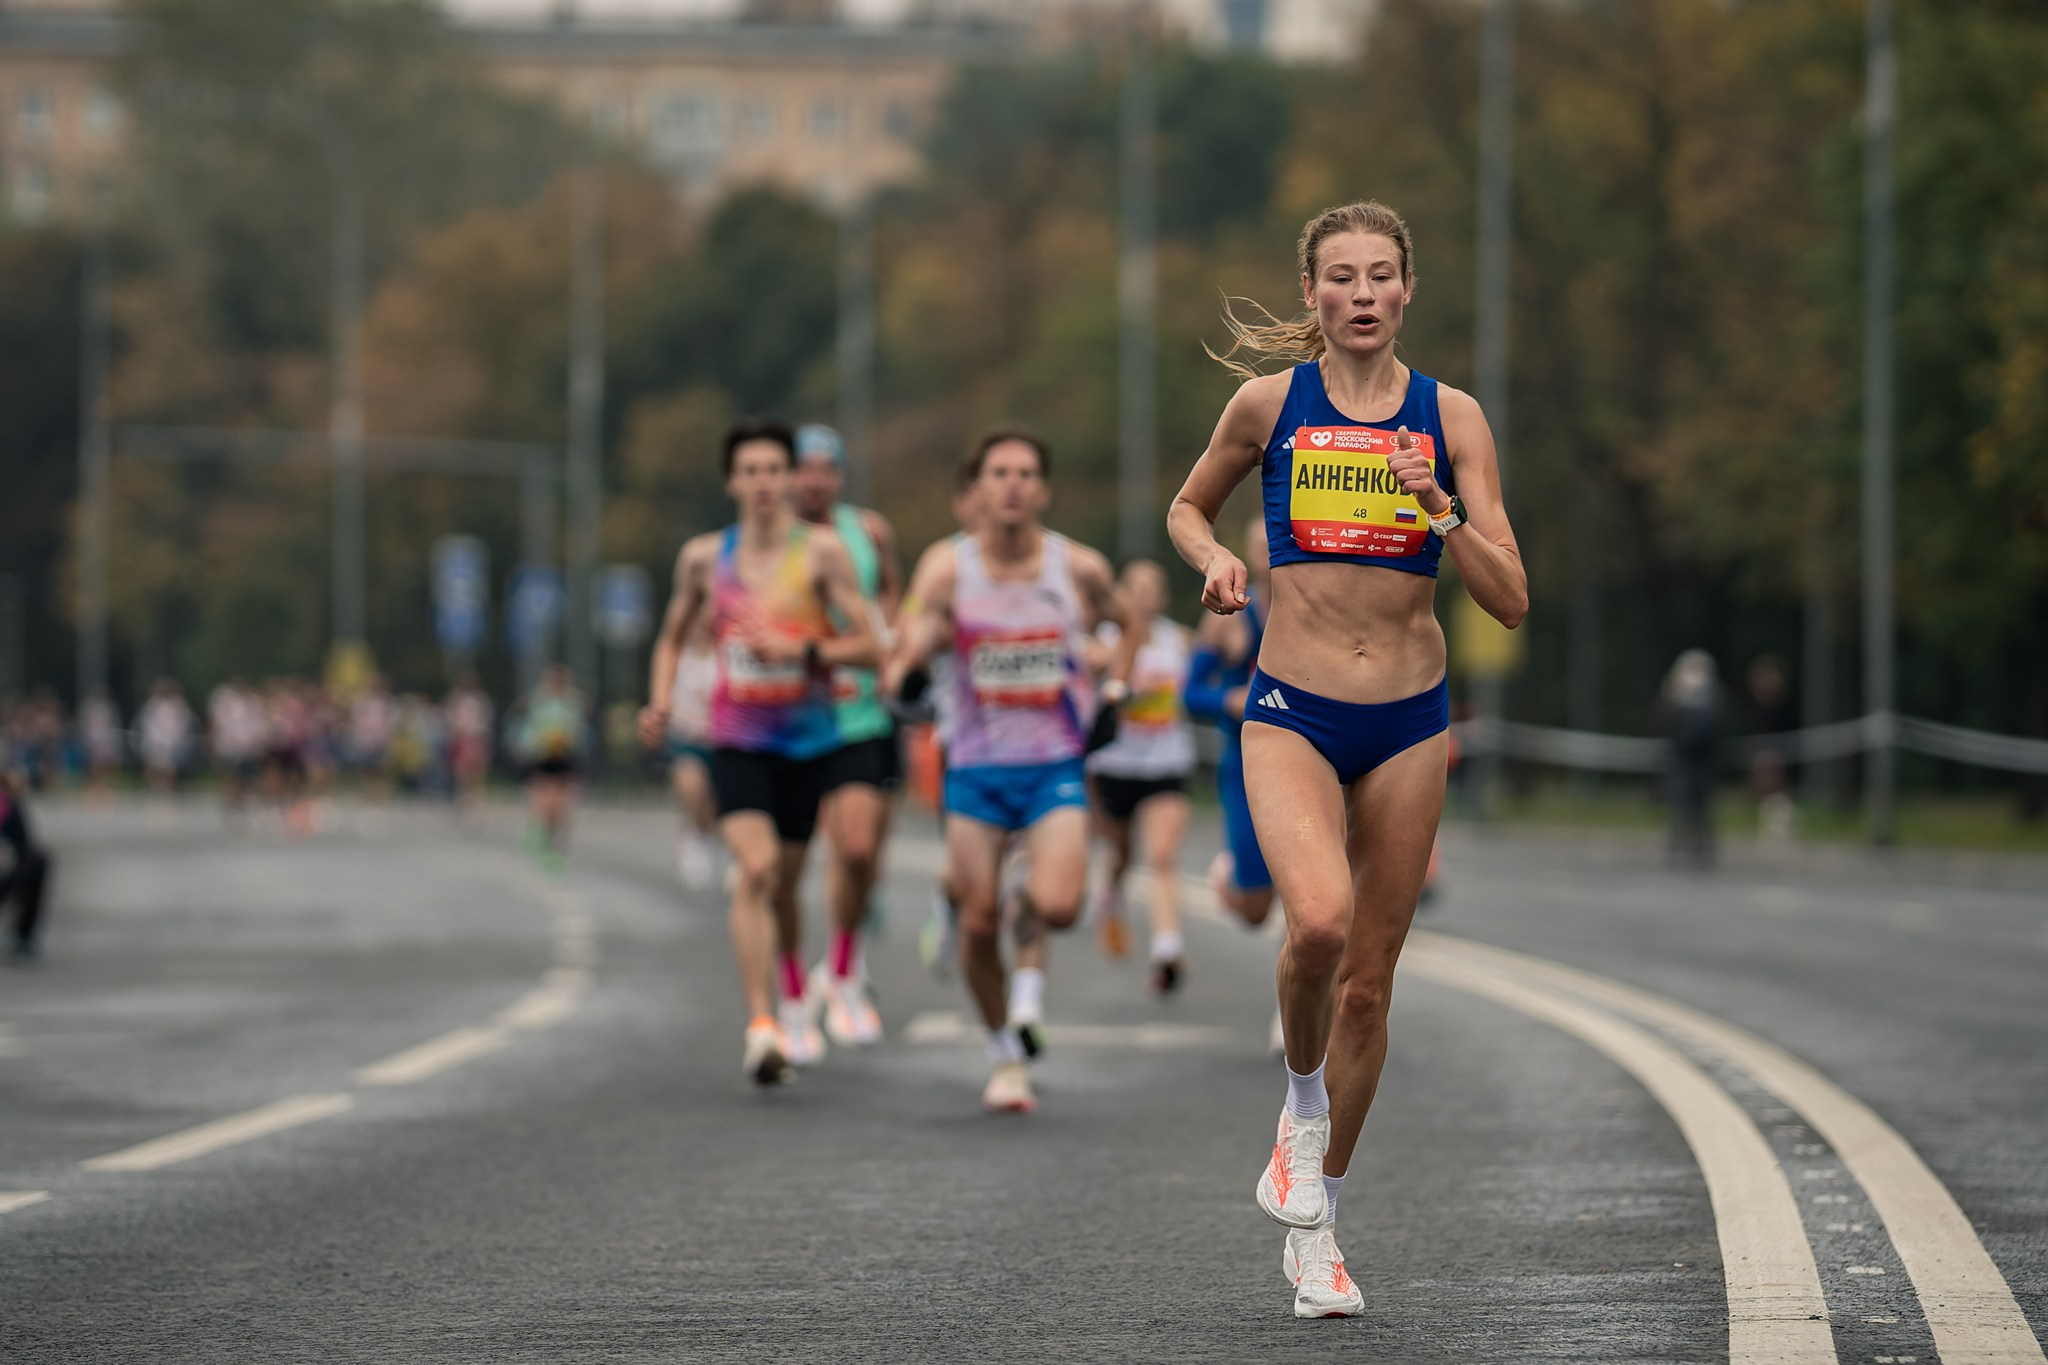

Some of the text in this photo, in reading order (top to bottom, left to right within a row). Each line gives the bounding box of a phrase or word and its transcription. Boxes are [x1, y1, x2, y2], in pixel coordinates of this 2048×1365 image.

[1334, 436, 1383, 445] МОСКОВСКИЙ
[1334, 441, 1371, 450] МАРАФОН
[1296, 464, 1415, 496] АННЕНКО
[1353, 508, 1367, 518] 48
